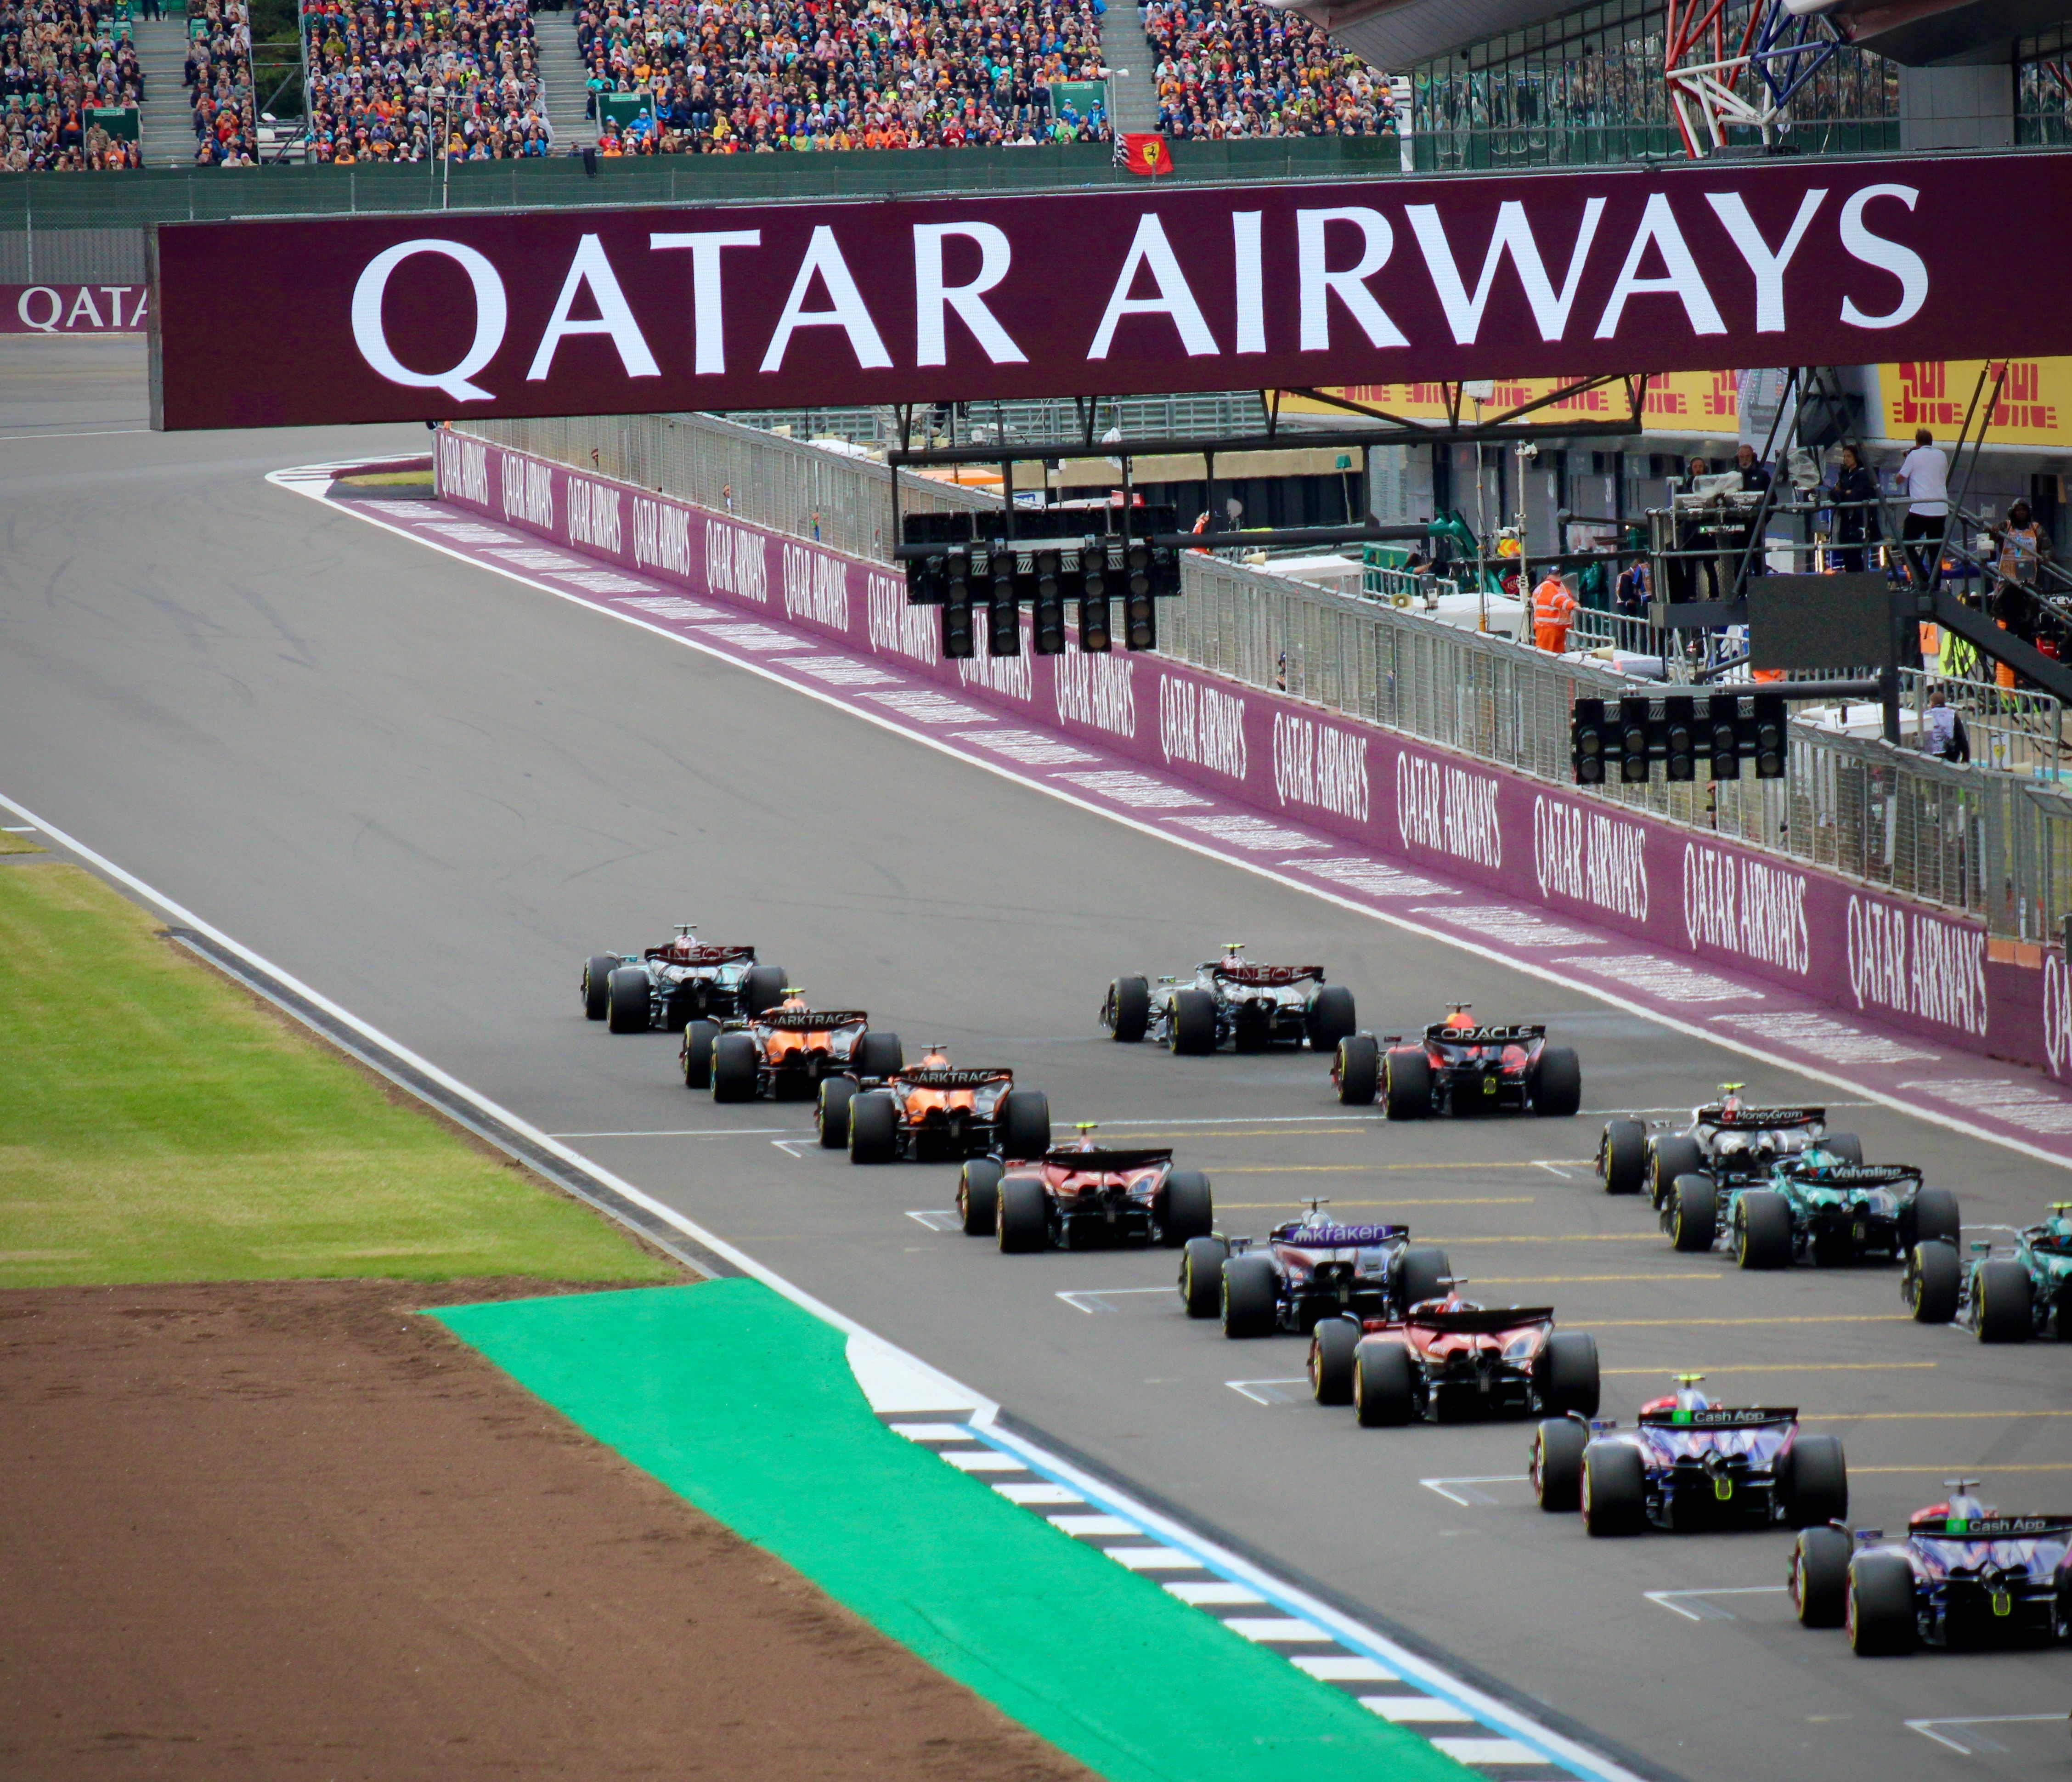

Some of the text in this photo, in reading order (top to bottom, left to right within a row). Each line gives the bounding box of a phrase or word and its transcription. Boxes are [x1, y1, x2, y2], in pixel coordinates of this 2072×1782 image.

[352, 184, 1928, 402] QATAR AIRWAYS
[440, 433, 488, 506] QATAR AIRWAYS
[502, 453, 553, 530] QATAR AIRWAYS
[567, 476, 621, 554] QATAR AIRWAYS
[633, 496, 690, 577] QATAR AIRWAYS
[706, 519, 767, 604] QATAR AIRWAYS
[783, 543, 848, 632] QATAR AIRWAYS
[868, 572, 898, 652] QATAR
[1092, 652, 1135, 738] AIRWAYS
[1160, 673, 1247, 781] QATAR AIRWAYS
[1273, 712, 1369, 823] QATAR AIRWAYS
[1397, 751, 1501, 869] QATAR AIRWAYS
[1534, 795, 1648, 922] QATAR AIRWAYS
[1683, 842, 1809, 976] QATAR AIRWAYS
[667, 947, 734, 961] INEOS
[1236, 967, 1304, 981] INEOS
[1848, 894, 1908, 1009] QATAR
[1912, 914, 1987, 1037] AIRWAYS
[1441, 1026, 1532, 1039] ORACLE
[1736, 1110, 1803, 1120] MoneyGram
[1830, 1165, 1902, 1178] Valvoline
[1313, 1225, 1386, 1242] kraken
[1694, 1410, 1764, 1422] Cash App
[1969, 1518, 2045, 1531] Cash App
